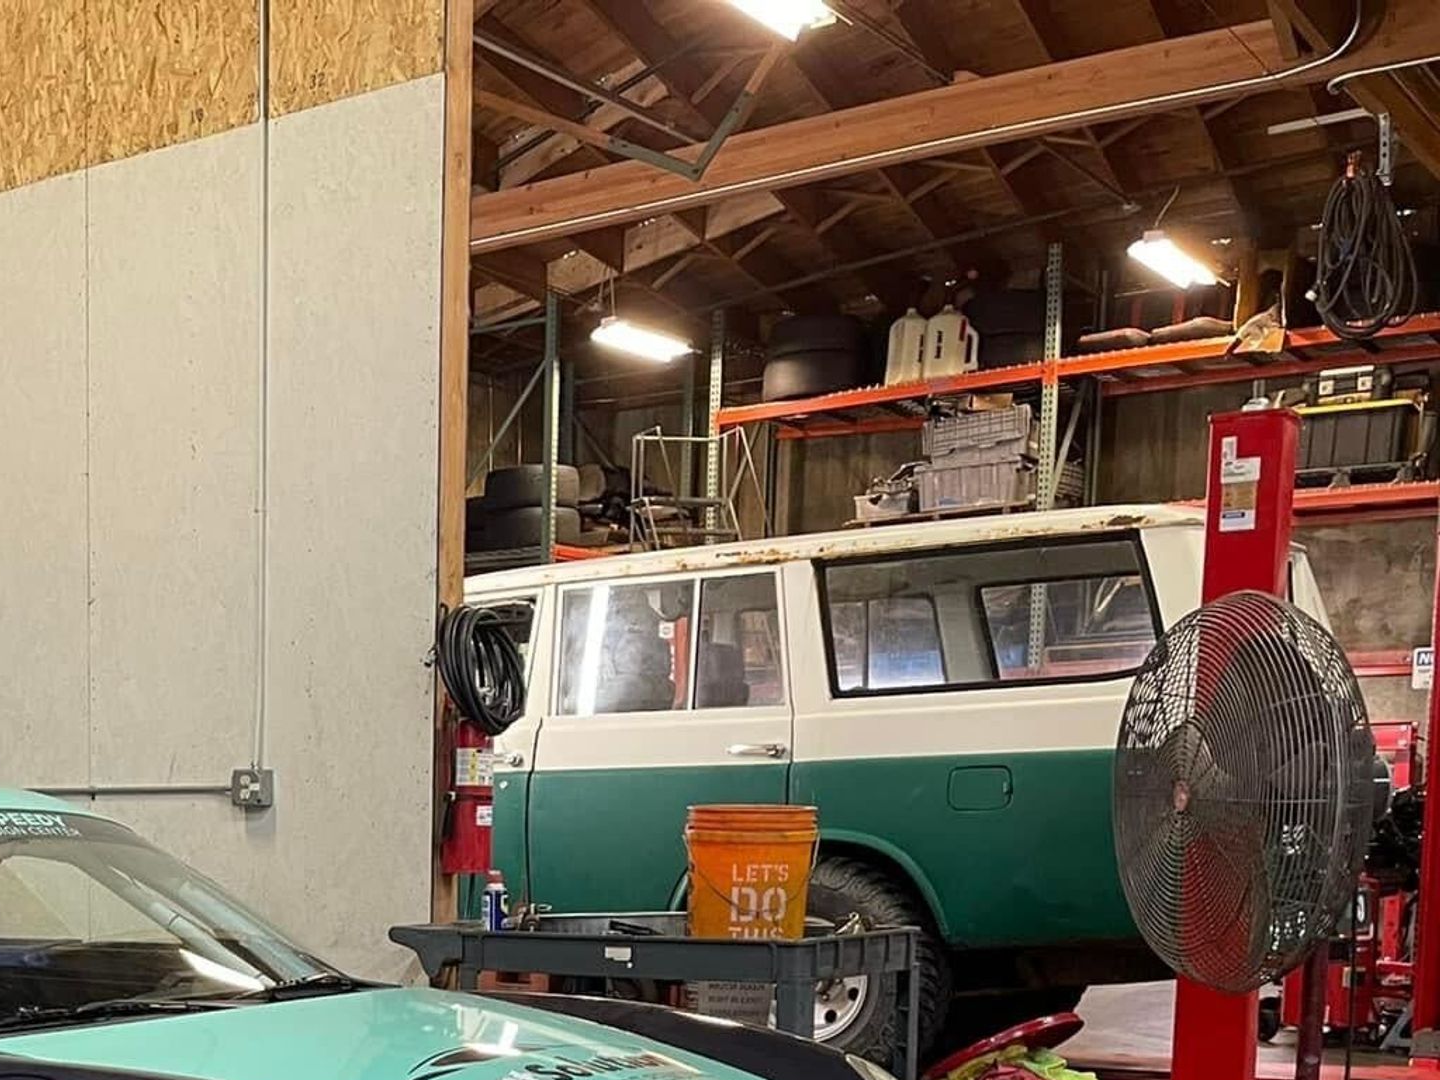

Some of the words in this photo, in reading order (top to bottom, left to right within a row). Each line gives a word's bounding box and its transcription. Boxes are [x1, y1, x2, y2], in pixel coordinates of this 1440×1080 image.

[29, 826, 82, 838] CENTER
[732, 864, 789, 882] LET'S
[731, 886, 787, 922] DO
